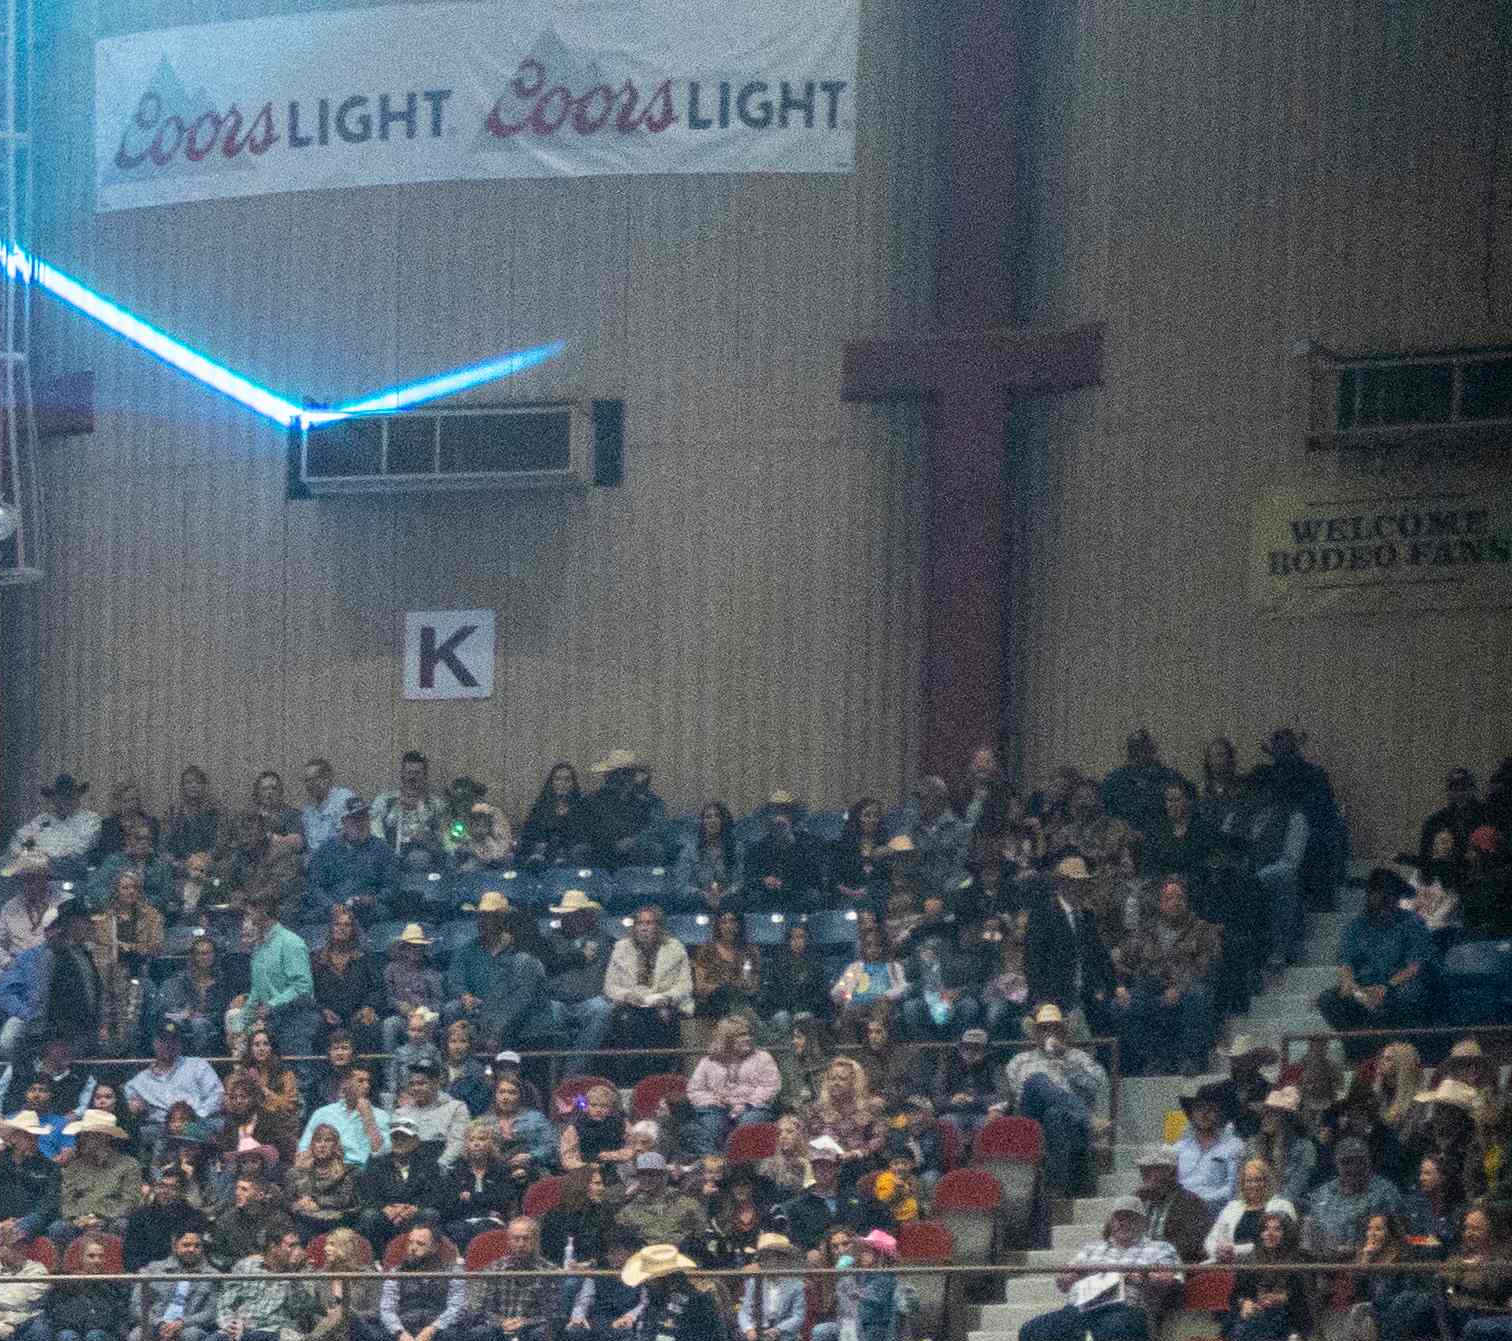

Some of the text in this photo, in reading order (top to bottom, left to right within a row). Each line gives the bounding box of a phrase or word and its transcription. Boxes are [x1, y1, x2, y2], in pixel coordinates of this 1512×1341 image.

[113, 87, 452, 171] Coors LIGHT
[486, 58, 850, 141] Coors LIGHT
[418, 623, 482, 689] K
